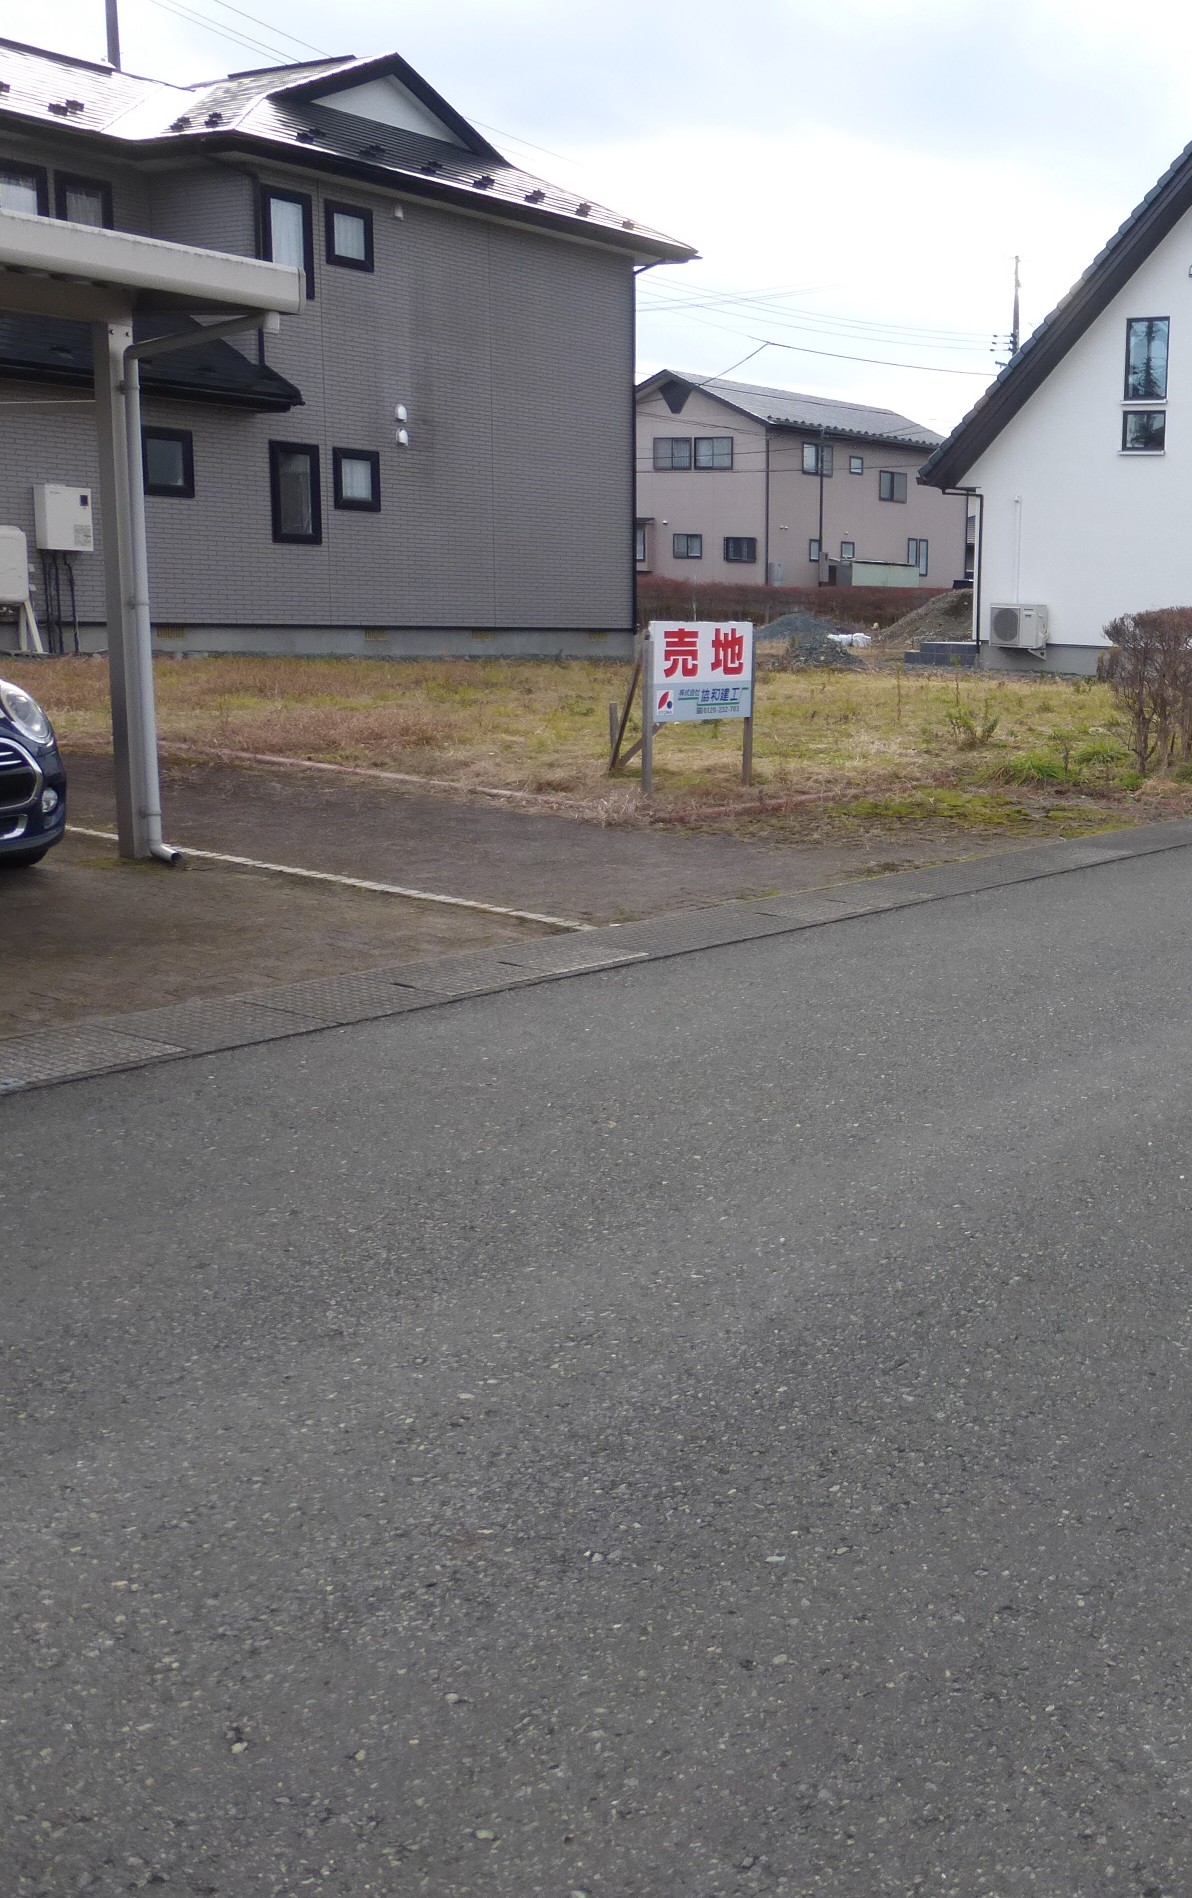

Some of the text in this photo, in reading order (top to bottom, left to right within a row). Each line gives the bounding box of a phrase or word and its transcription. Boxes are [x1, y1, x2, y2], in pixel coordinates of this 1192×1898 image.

[664, 628, 744, 678] 売地
[701, 687, 740, 702] 協和建工
